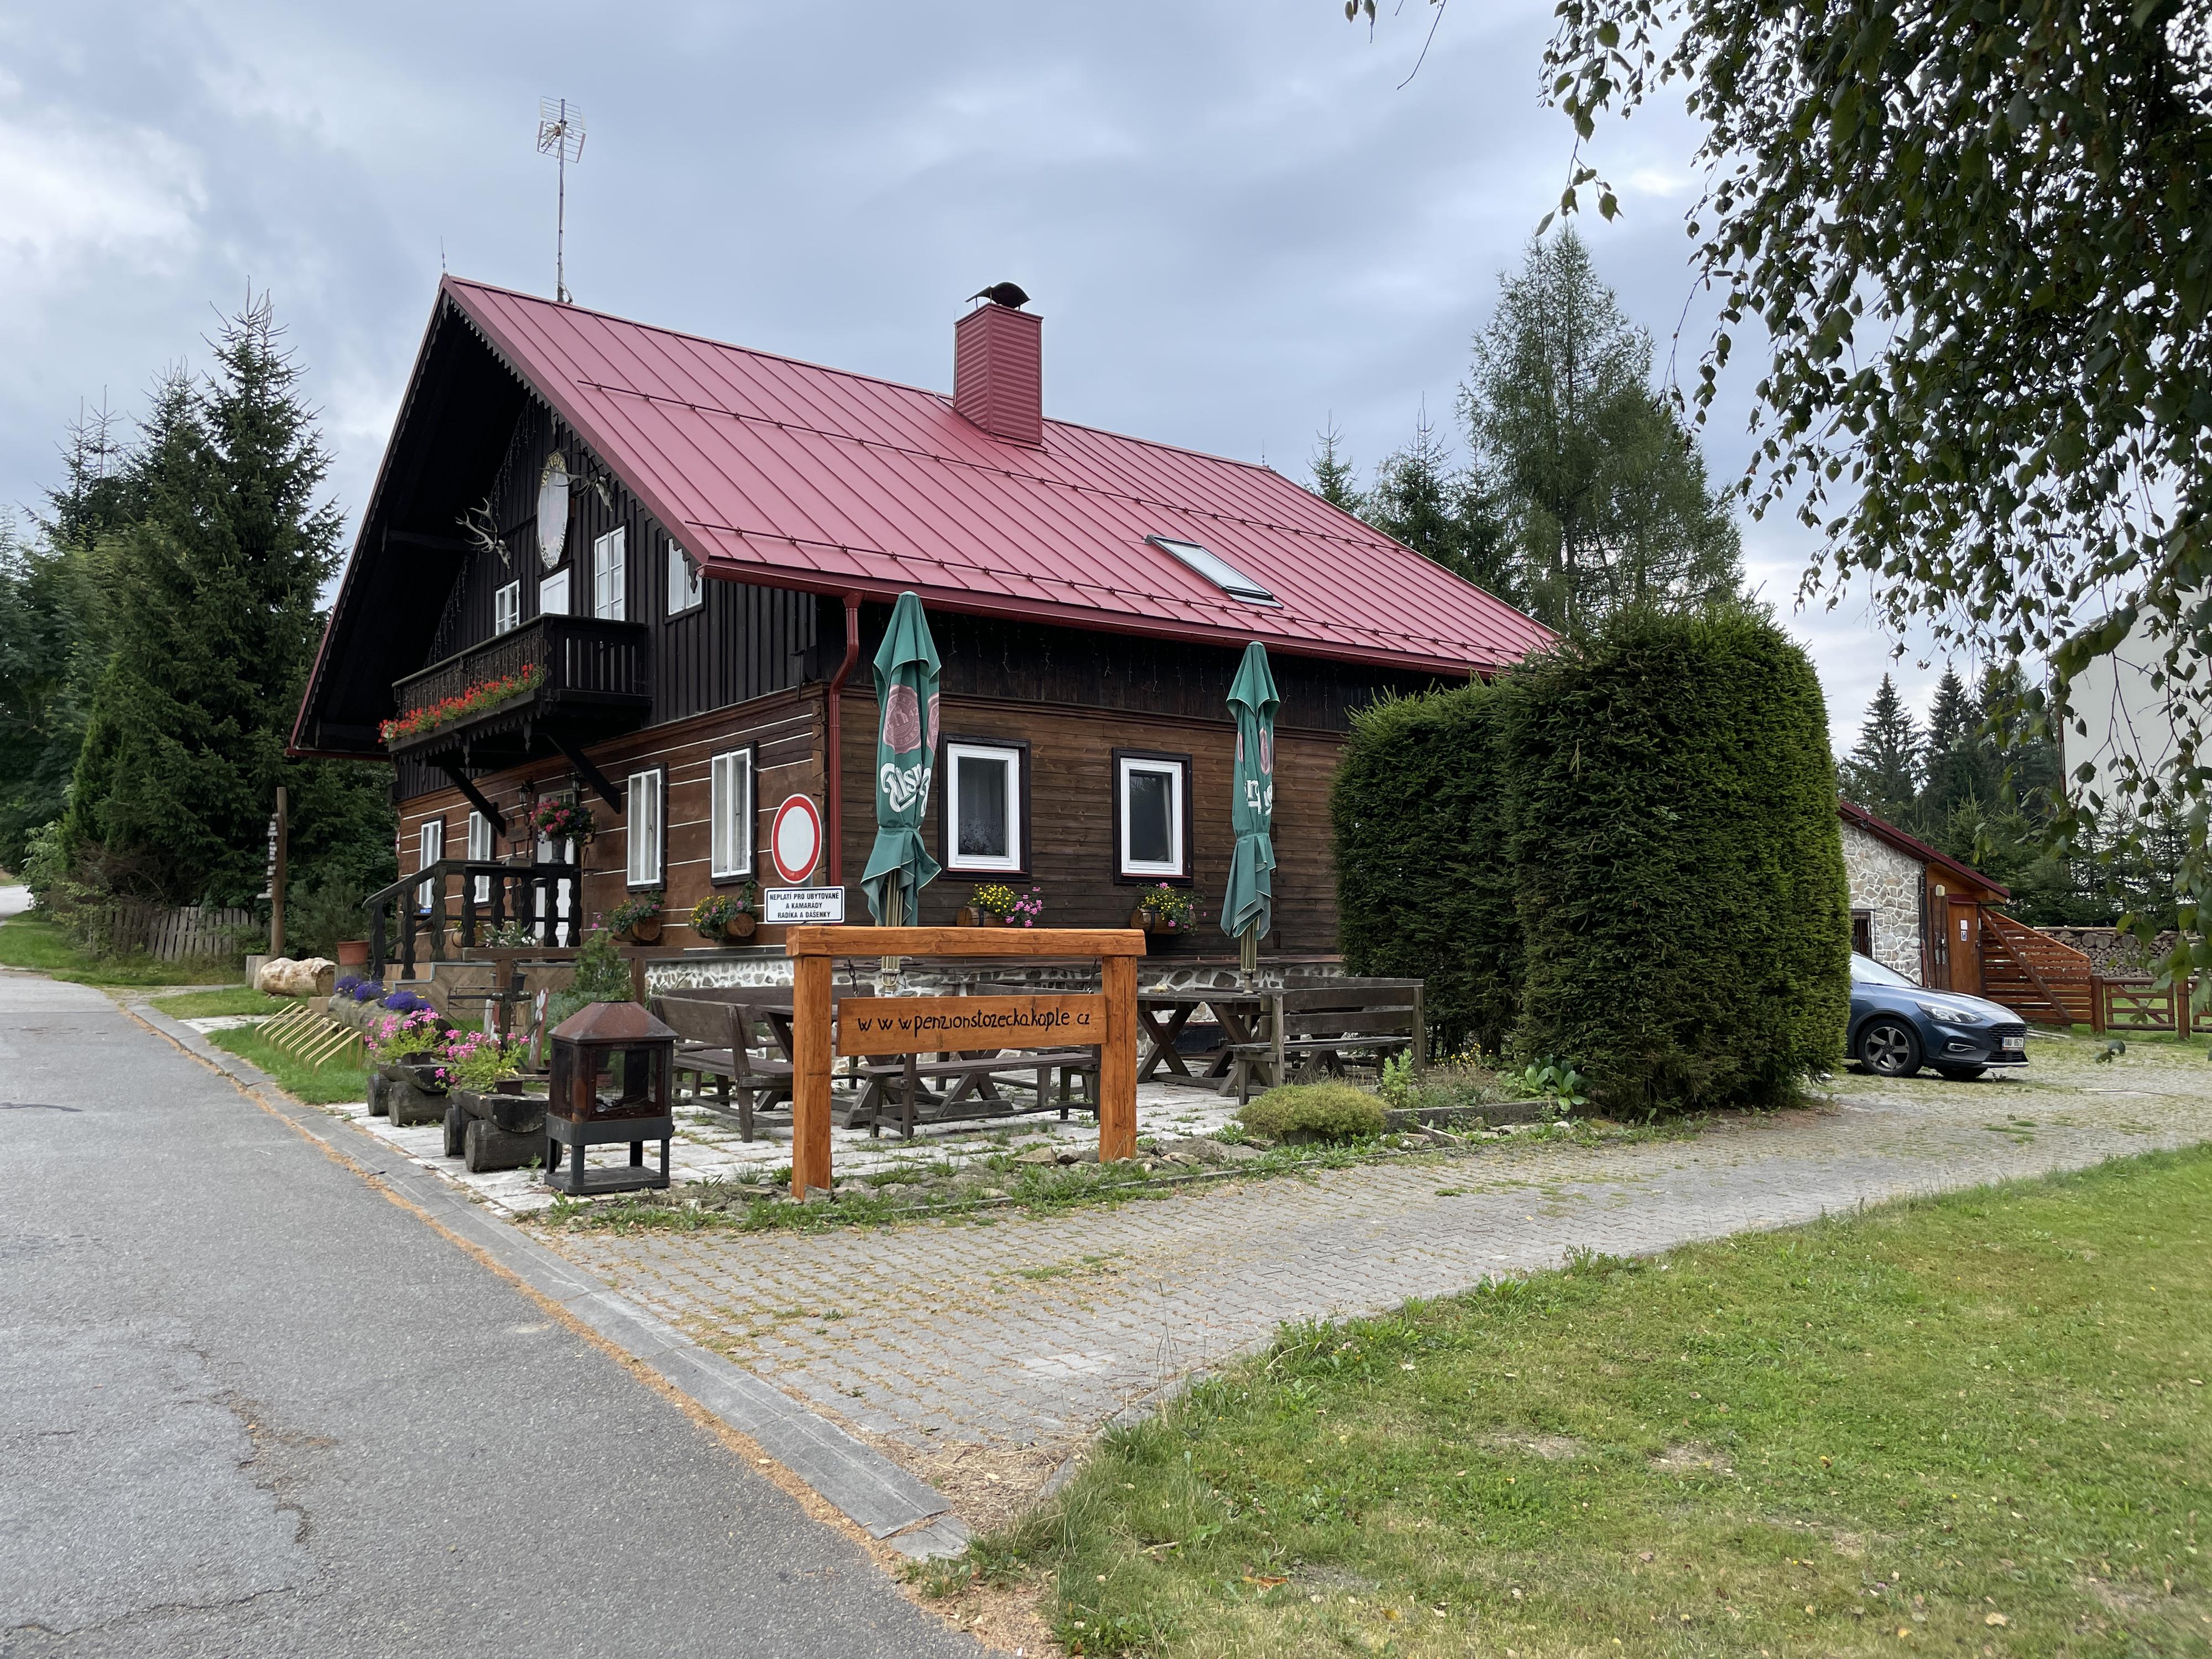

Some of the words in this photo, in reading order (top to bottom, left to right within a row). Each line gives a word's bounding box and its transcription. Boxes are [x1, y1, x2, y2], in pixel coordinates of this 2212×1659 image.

[770, 892, 792, 900] NEPLATÍ
[807, 891, 839, 900] UBYTOVANÉ
[778, 910, 798, 919] RADÍKA
[805, 910, 831, 918] DÁŠENKY
